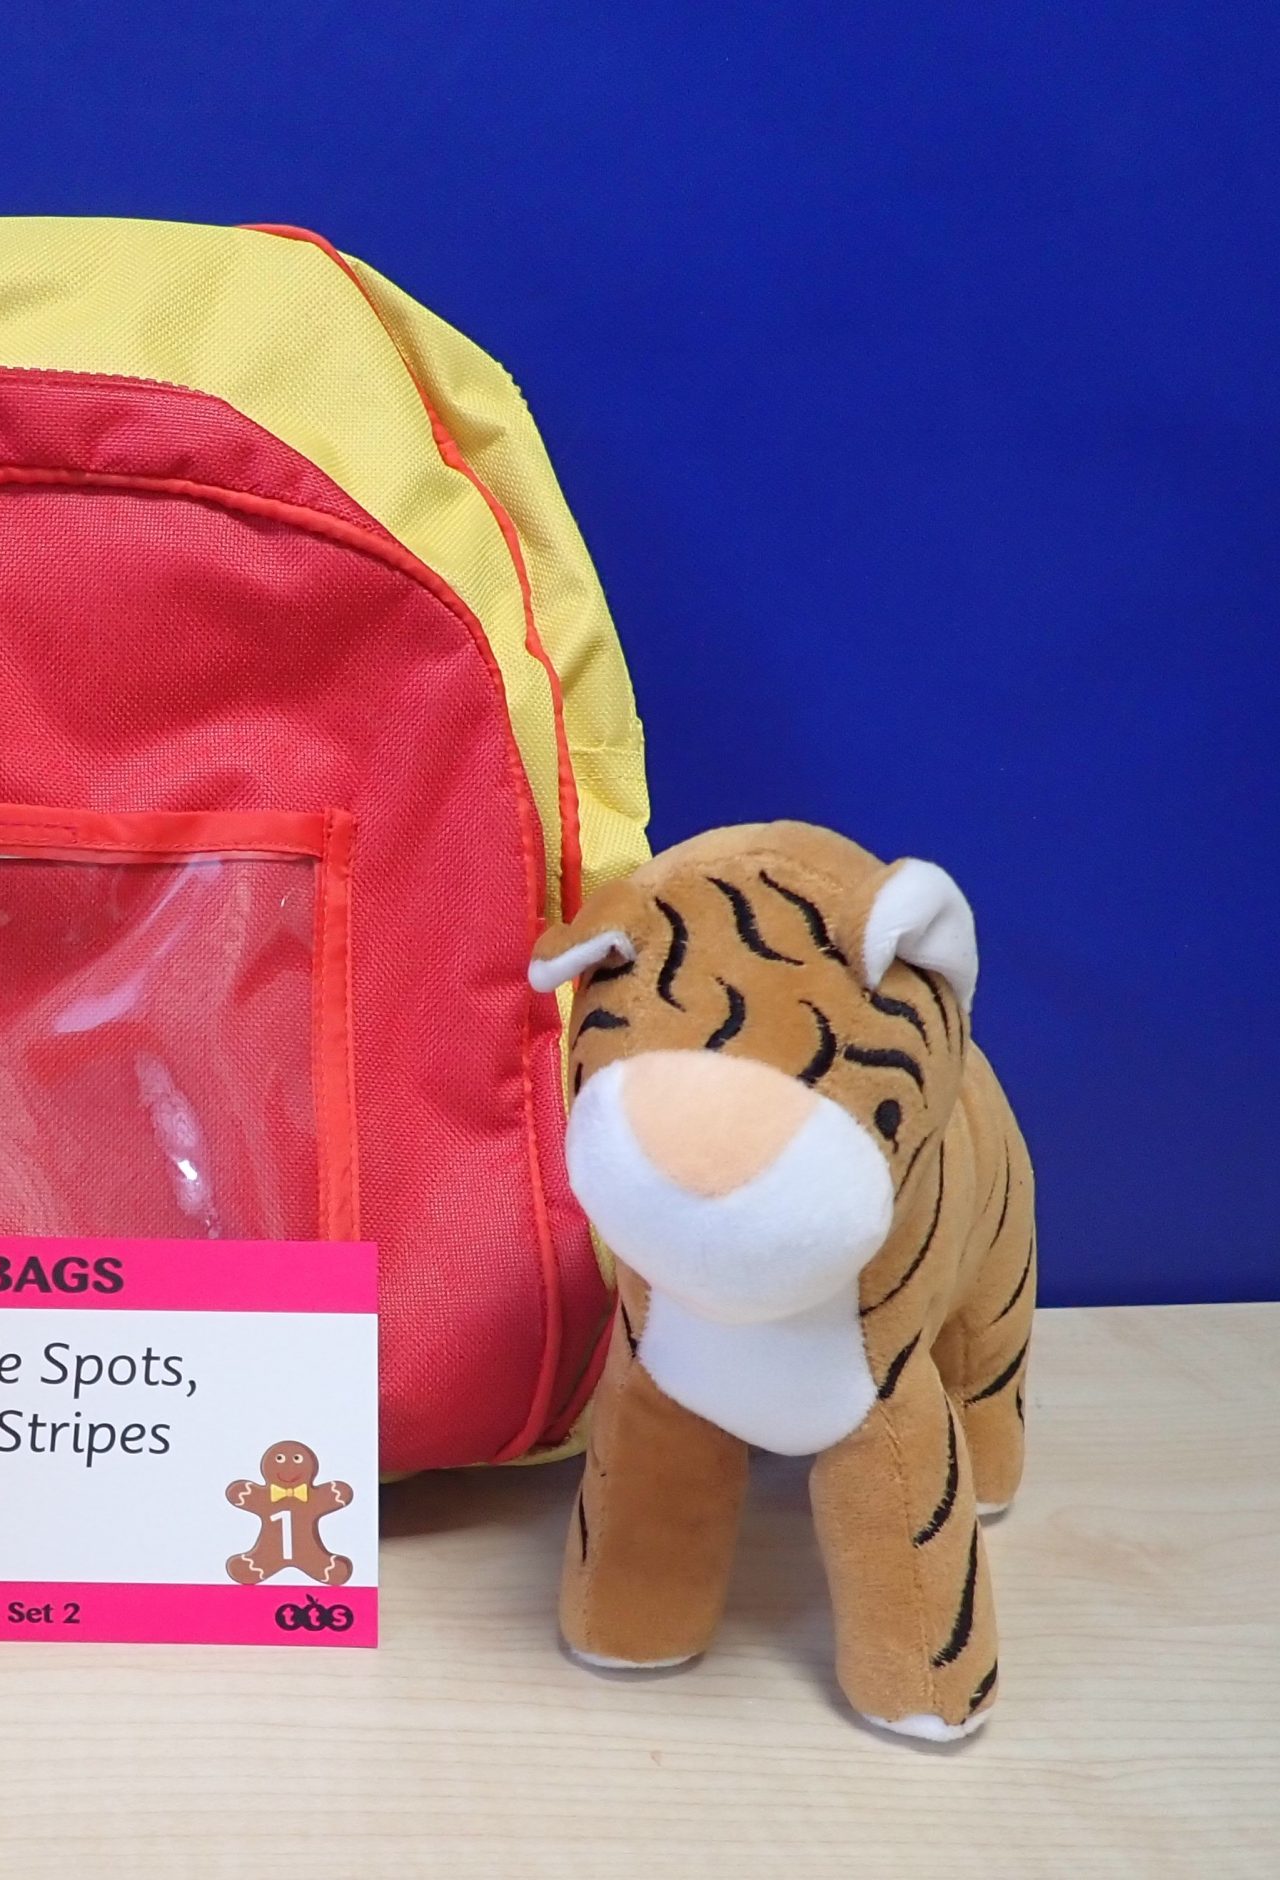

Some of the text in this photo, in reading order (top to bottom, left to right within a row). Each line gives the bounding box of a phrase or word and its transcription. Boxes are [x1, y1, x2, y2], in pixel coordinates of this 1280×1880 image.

[41, 1342, 198, 1398] Spots,
[270, 1510, 292, 1560] 1
[7, 1602, 54, 1624] Set
[62, 1603, 81, 1624] 2
[278, 1604, 350, 1628] tts
